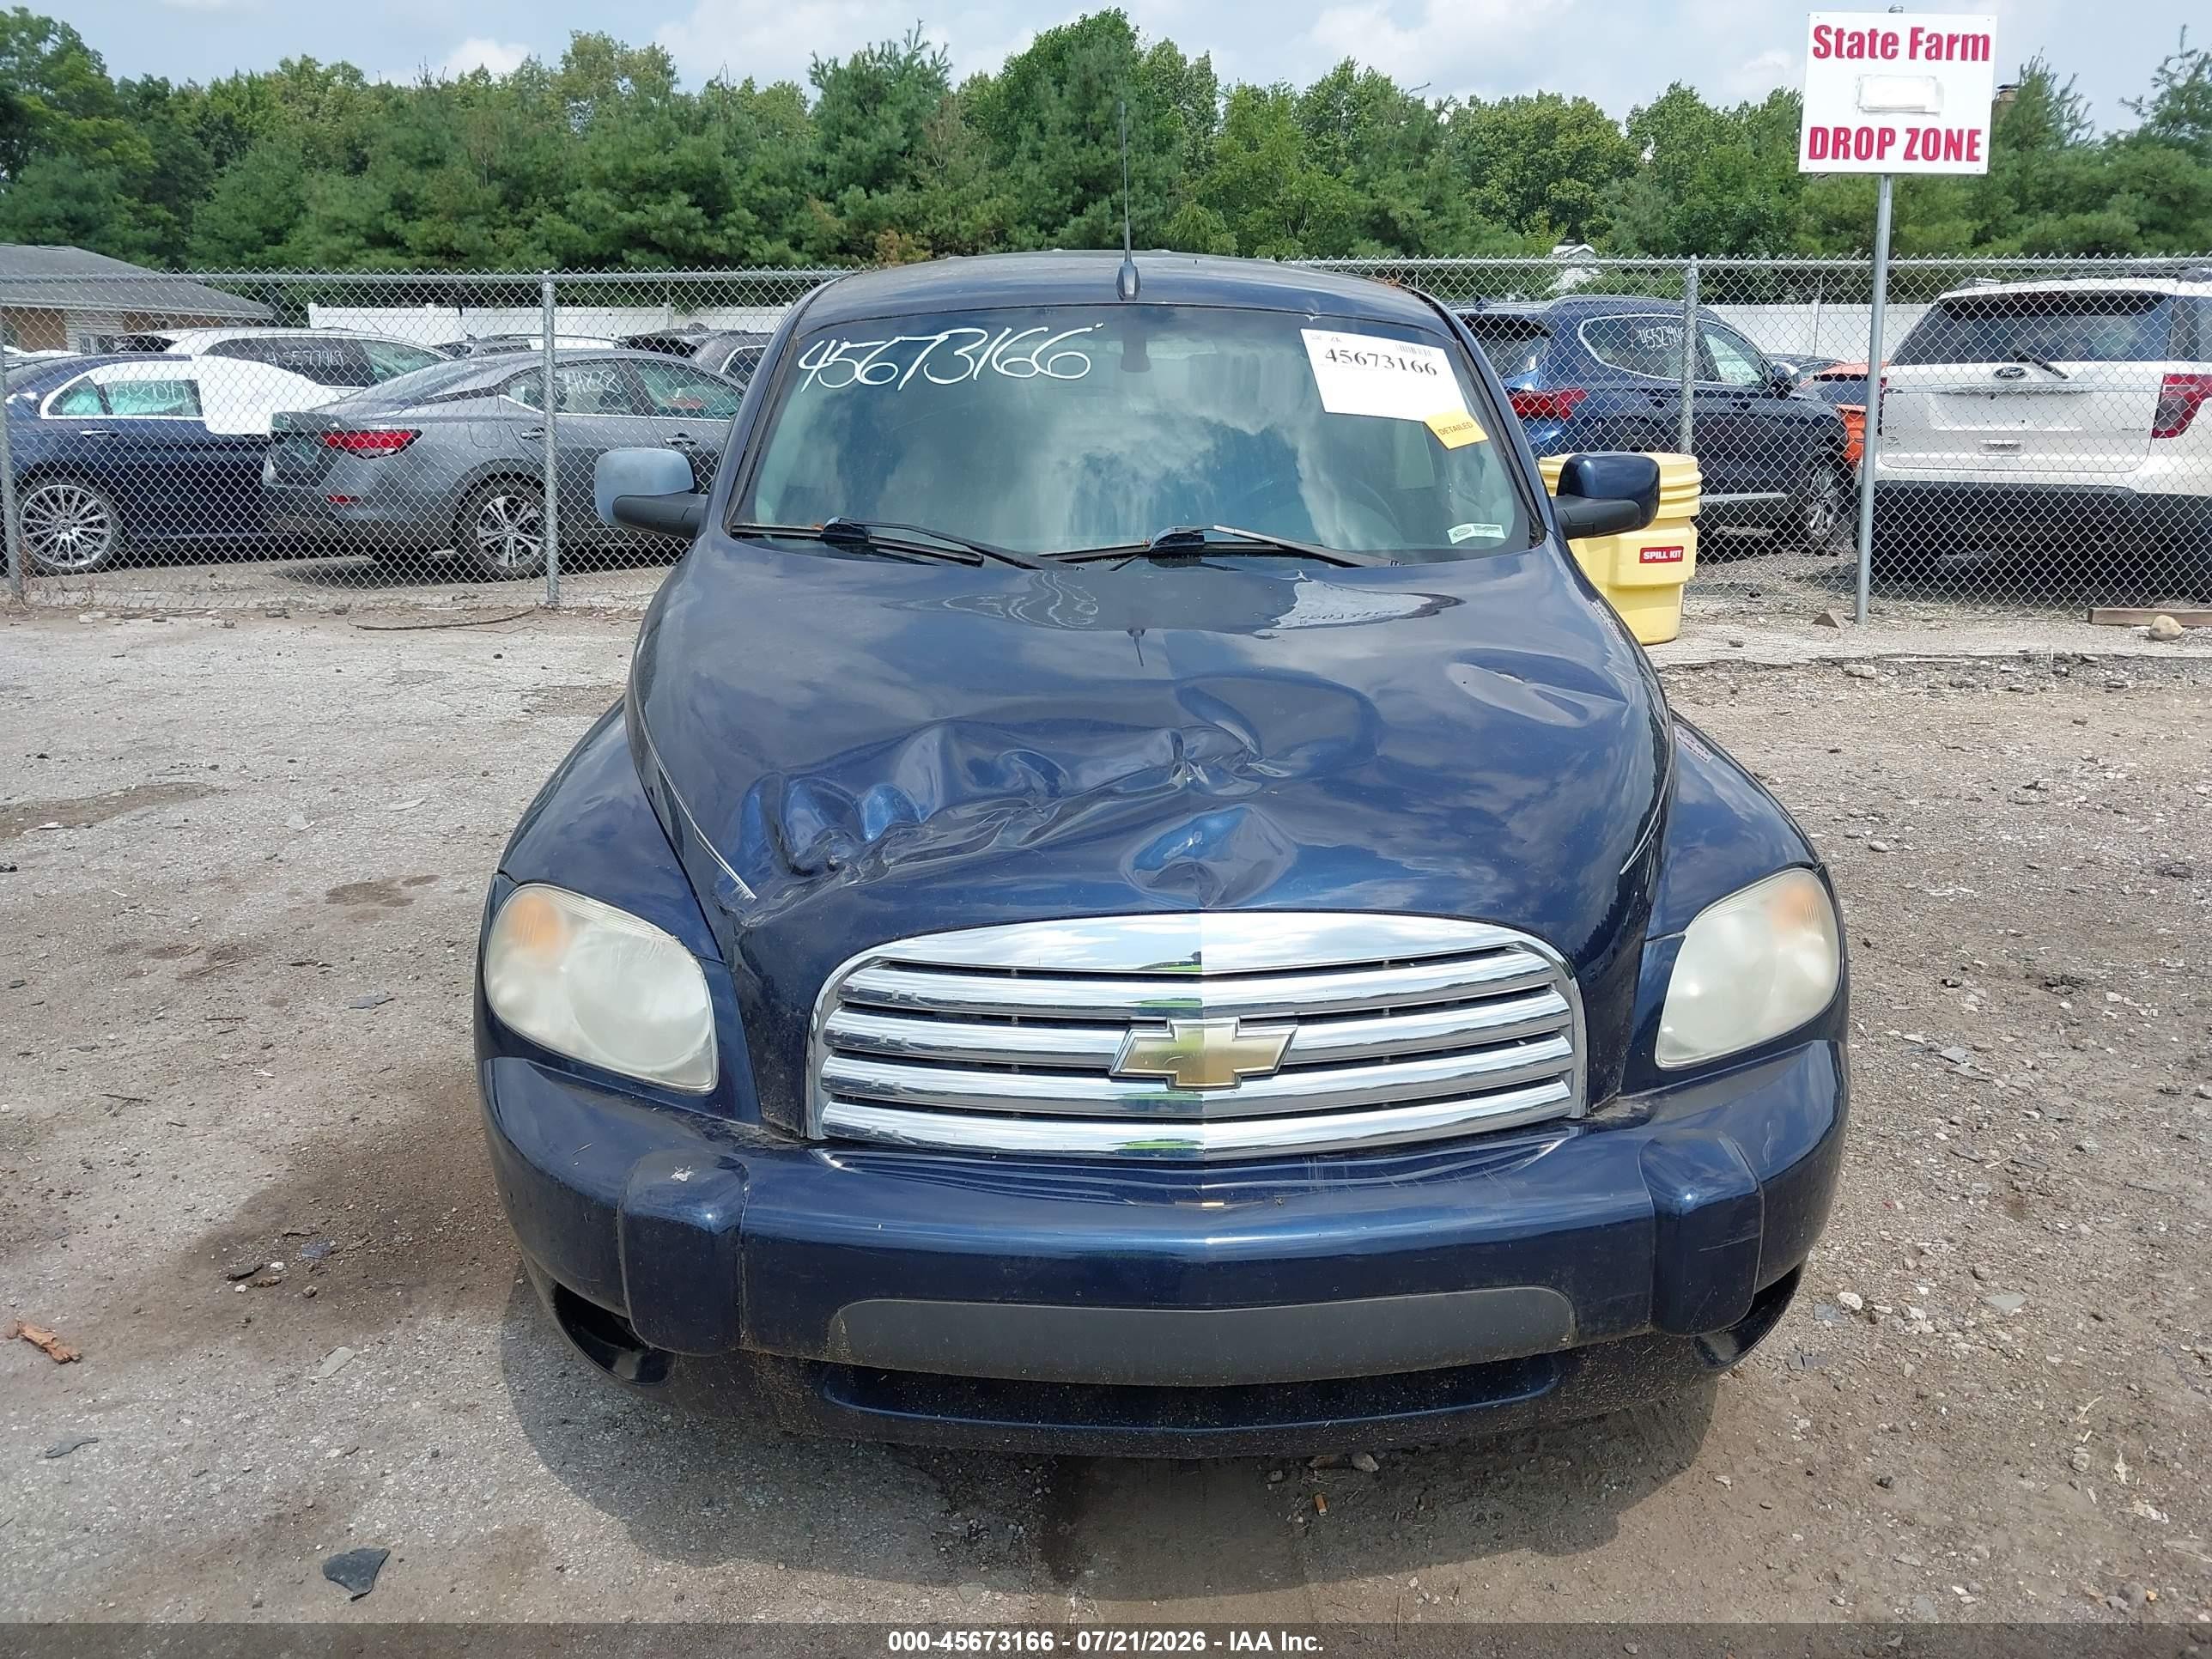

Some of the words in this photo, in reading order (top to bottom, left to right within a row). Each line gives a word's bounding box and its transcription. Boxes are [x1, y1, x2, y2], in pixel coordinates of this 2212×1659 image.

[1813, 24, 1899, 60] State
[1908, 27, 1990, 62] Farm
[1808, 126, 1896, 161] DROP
[1903, 128, 1982, 162] ZONE
[798, 325, 1096, 392] 45673166
[1325, 348, 1437, 376] 45673166
[1437, 421, 1474, 436] DETAILED
[1643, 550, 1668, 560] SPILL
[1669, 550, 1683, 558] KIT
